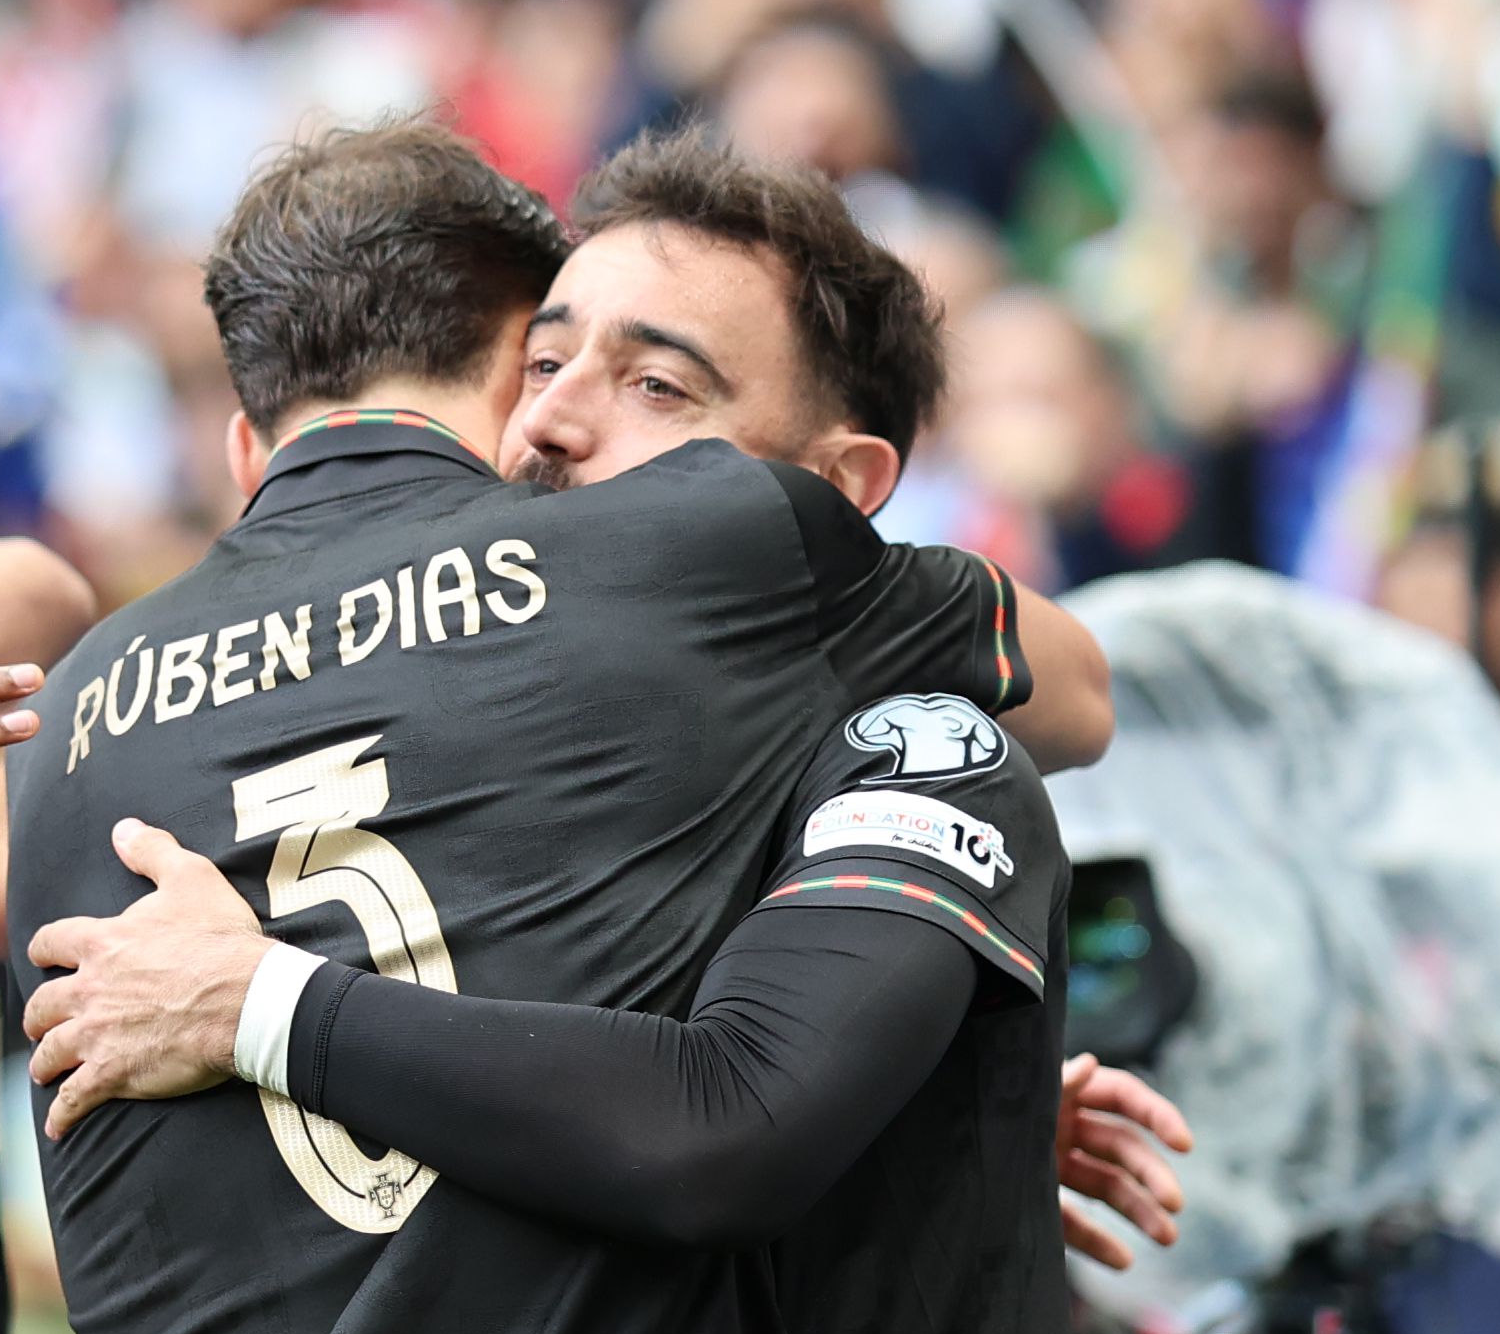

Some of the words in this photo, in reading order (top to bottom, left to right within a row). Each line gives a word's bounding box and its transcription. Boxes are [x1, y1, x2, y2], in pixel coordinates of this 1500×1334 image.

[66, 603, 313, 775] RÚBEN
[337, 539, 547, 666] DIAS
[950, 821, 992, 866] 10
[232, 734, 459, 1234] 3
